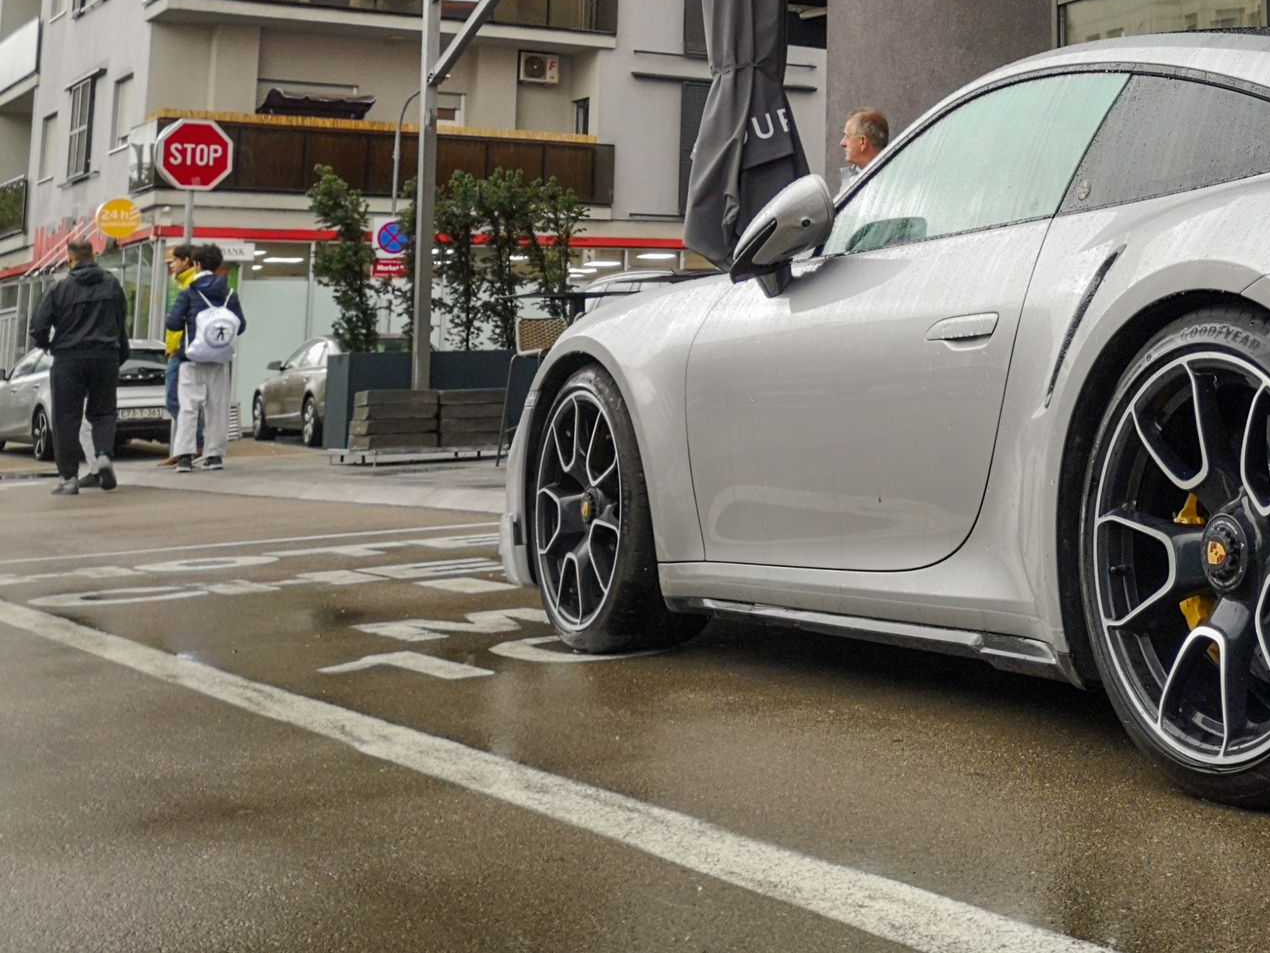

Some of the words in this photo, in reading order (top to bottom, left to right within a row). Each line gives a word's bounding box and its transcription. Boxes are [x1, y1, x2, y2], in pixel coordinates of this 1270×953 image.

[169, 142, 222, 167] STOP
[101, 209, 118, 220] 24
[120, 209, 129, 220] h
